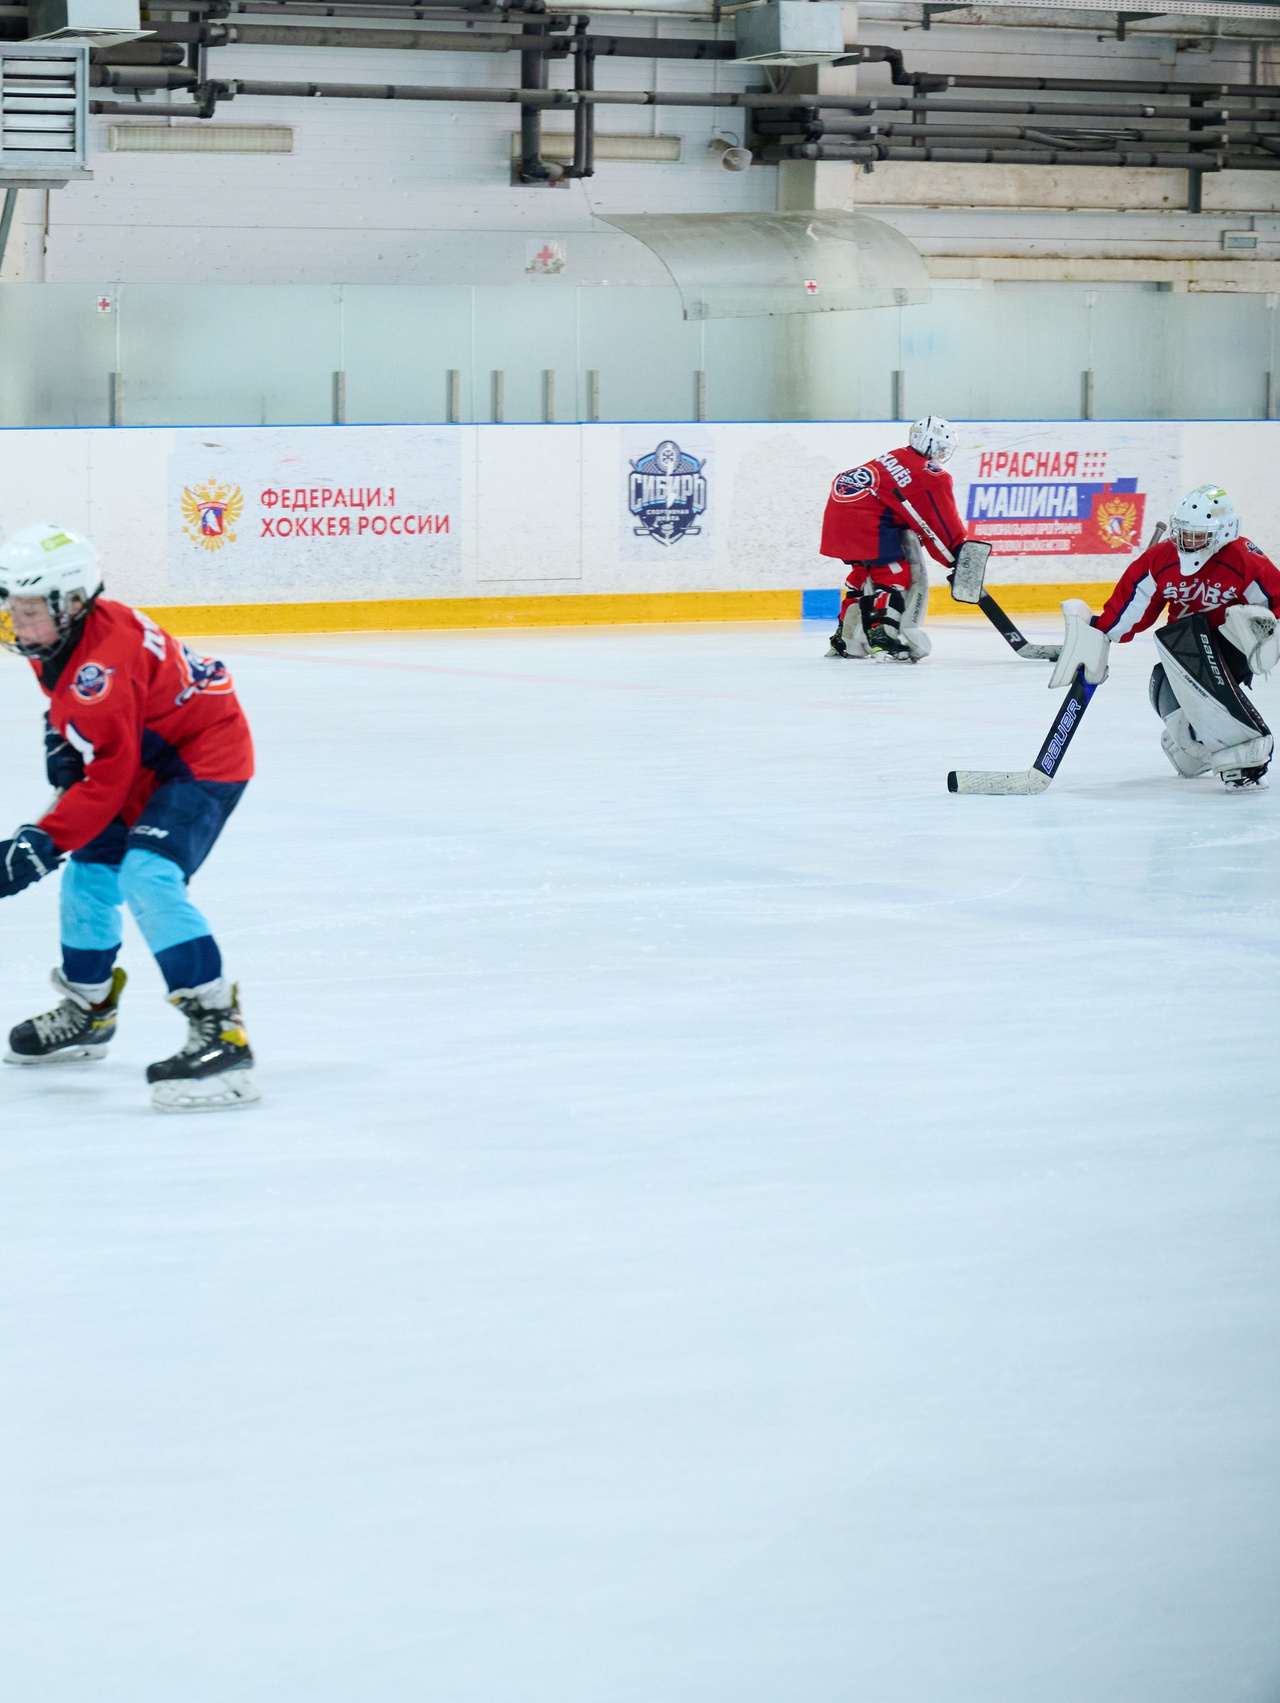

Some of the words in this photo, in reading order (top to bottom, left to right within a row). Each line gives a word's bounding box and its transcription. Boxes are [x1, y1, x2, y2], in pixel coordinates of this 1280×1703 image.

[978, 452, 1079, 478] КРАСНАЯ
[260, 487, 396, 512] ФЕДЕРАЦИЯ
[973, 486, 1078, 518] МАШИНА
[260, 517, 350, 538] ХОККЕЯ
[358, 514, 450, 536] РОССИИ
[1163, 582, 1238, 605] STARS
[1200, 633, 1225, 687] BAUER
[1041, 698, 1081, 775] BAUER
